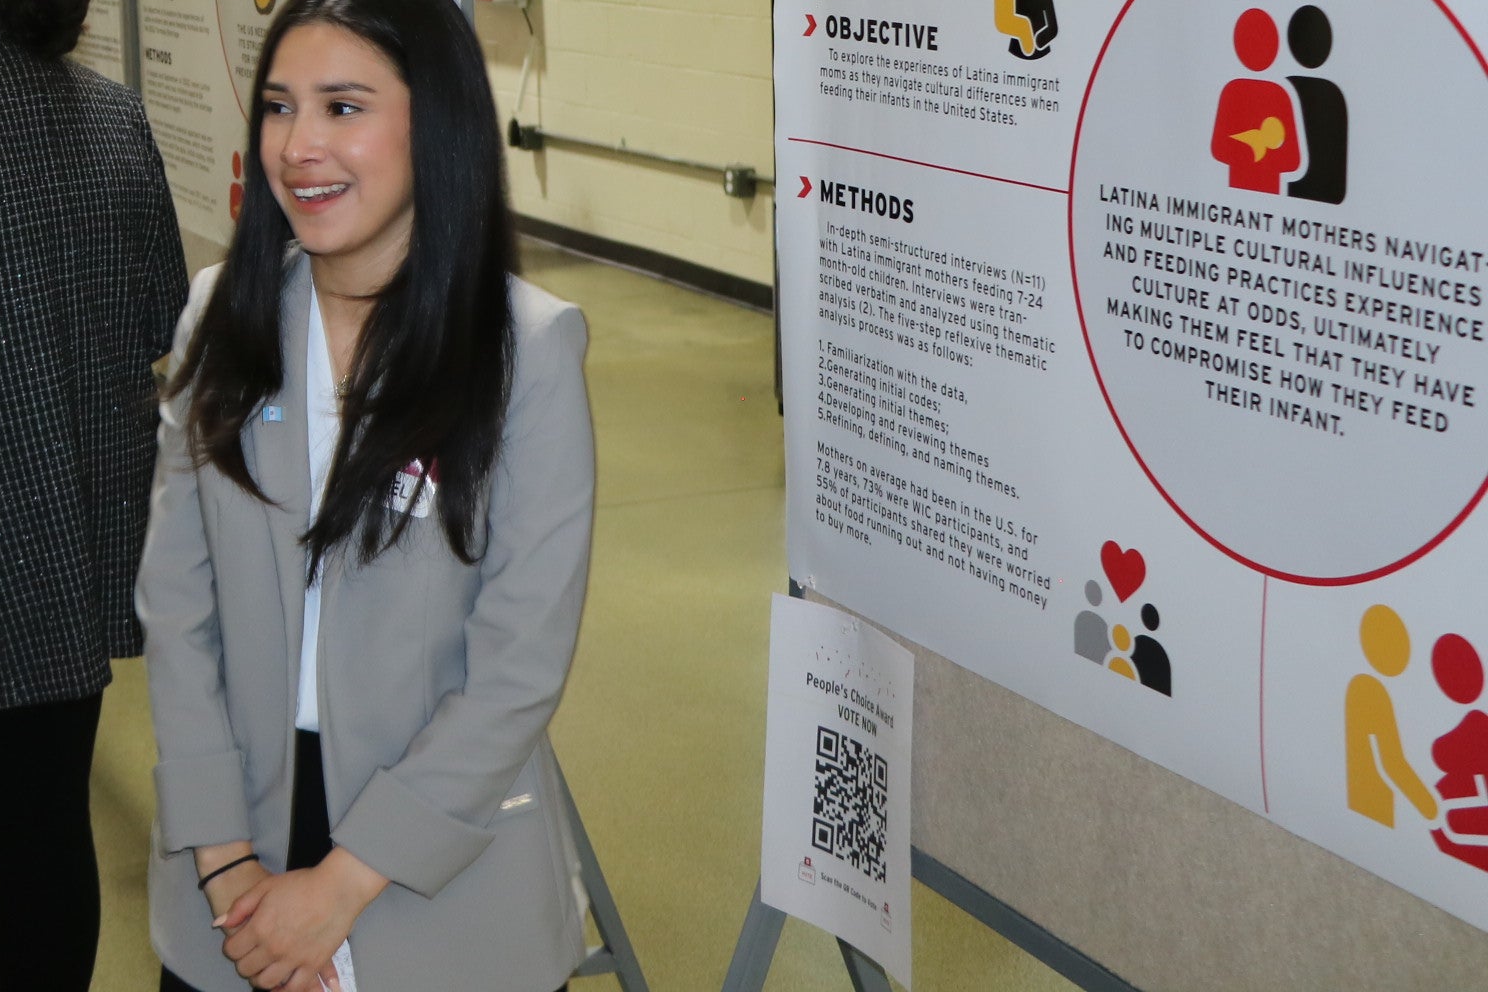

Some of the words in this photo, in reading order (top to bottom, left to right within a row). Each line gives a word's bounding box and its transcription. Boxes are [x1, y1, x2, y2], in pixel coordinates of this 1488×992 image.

[146, 48, 171, 65] METHODS
[825, 14, 937, 51] OBJECTIVE
[820, 67, 846, 79] moms
[848, 70, 858, 81] as
[861, 70, 880, 87] they
[883, 75, 922, 92] navigate
[925, 81, 962, 97] cultural
[966, 86, 1026, 107] differences
[1030, 95, 1058, 112] when
[828, 47, 838, 61] To
[840, 51, 873, 65] explore
[876, 54, 890, 68] the
[893, 59, 948, 76] experiences
[952, 64, 962, 78] of
[966, 66, 998, 83] Latina
[1002, 70, 1059, 92] immigrant
[820, 179, 913, 223] METHODS
[1100, 184, 1159, 211] LATINA
[1166, 196, 1273, 232] IMMIGRANT
[1282, 216, 1375, 252] MOTHERS
[1106, 213, 1133, 234] ING
[1140, 220, 1225, 253] MULTIPLE
[1234, 238, 1336, 276] CULTURAL
[1344, 260, 1480, 306] INFLUENCES
[1103, 241, 1136, 263] AND
[1144, 249, 1218, 282] FEEDING
[1227, 266, 1336, 307] PRACTICES
[1345, 292, 1482, 341] EXPERIENCE
[1132, 275, 1208, 309] CULTURE
[1217, 295, 1239, 315] AT
[1247, 301, 1305, 334] ODDS,
[1314, 316, 1440, 364] ULTIMATELY
[1107, 297, 1172, 329] MAKING
[1179, 314, 1228, 343] THEM
[1237, 328, 1284, 357] FEEL
[1292, 342, 1343, 371] THAT
[1351, 357, 1404, 387] THEY
[1414, 373, 1474, 407] HAVE
[1124, 329, 1144, 350] TO
[1150, 336, 1271, 384] COMPROMISE
[1280, 370, 1322, 397] HOW
[1331, 383, 1382, 414] THEY
[1392, 400, 1447, 432] FEED
[1205, 380, 1261, 412] THEIR
[1270, 397, 1343, 436] INFANT.
[806, 672, 848, 699] People's
[850, 688, 874, 713] Choice
[875, 703, 893, 728] Award
[838, 704, 860, 726] VOTE
[861, 715, 877, 736] NOW
